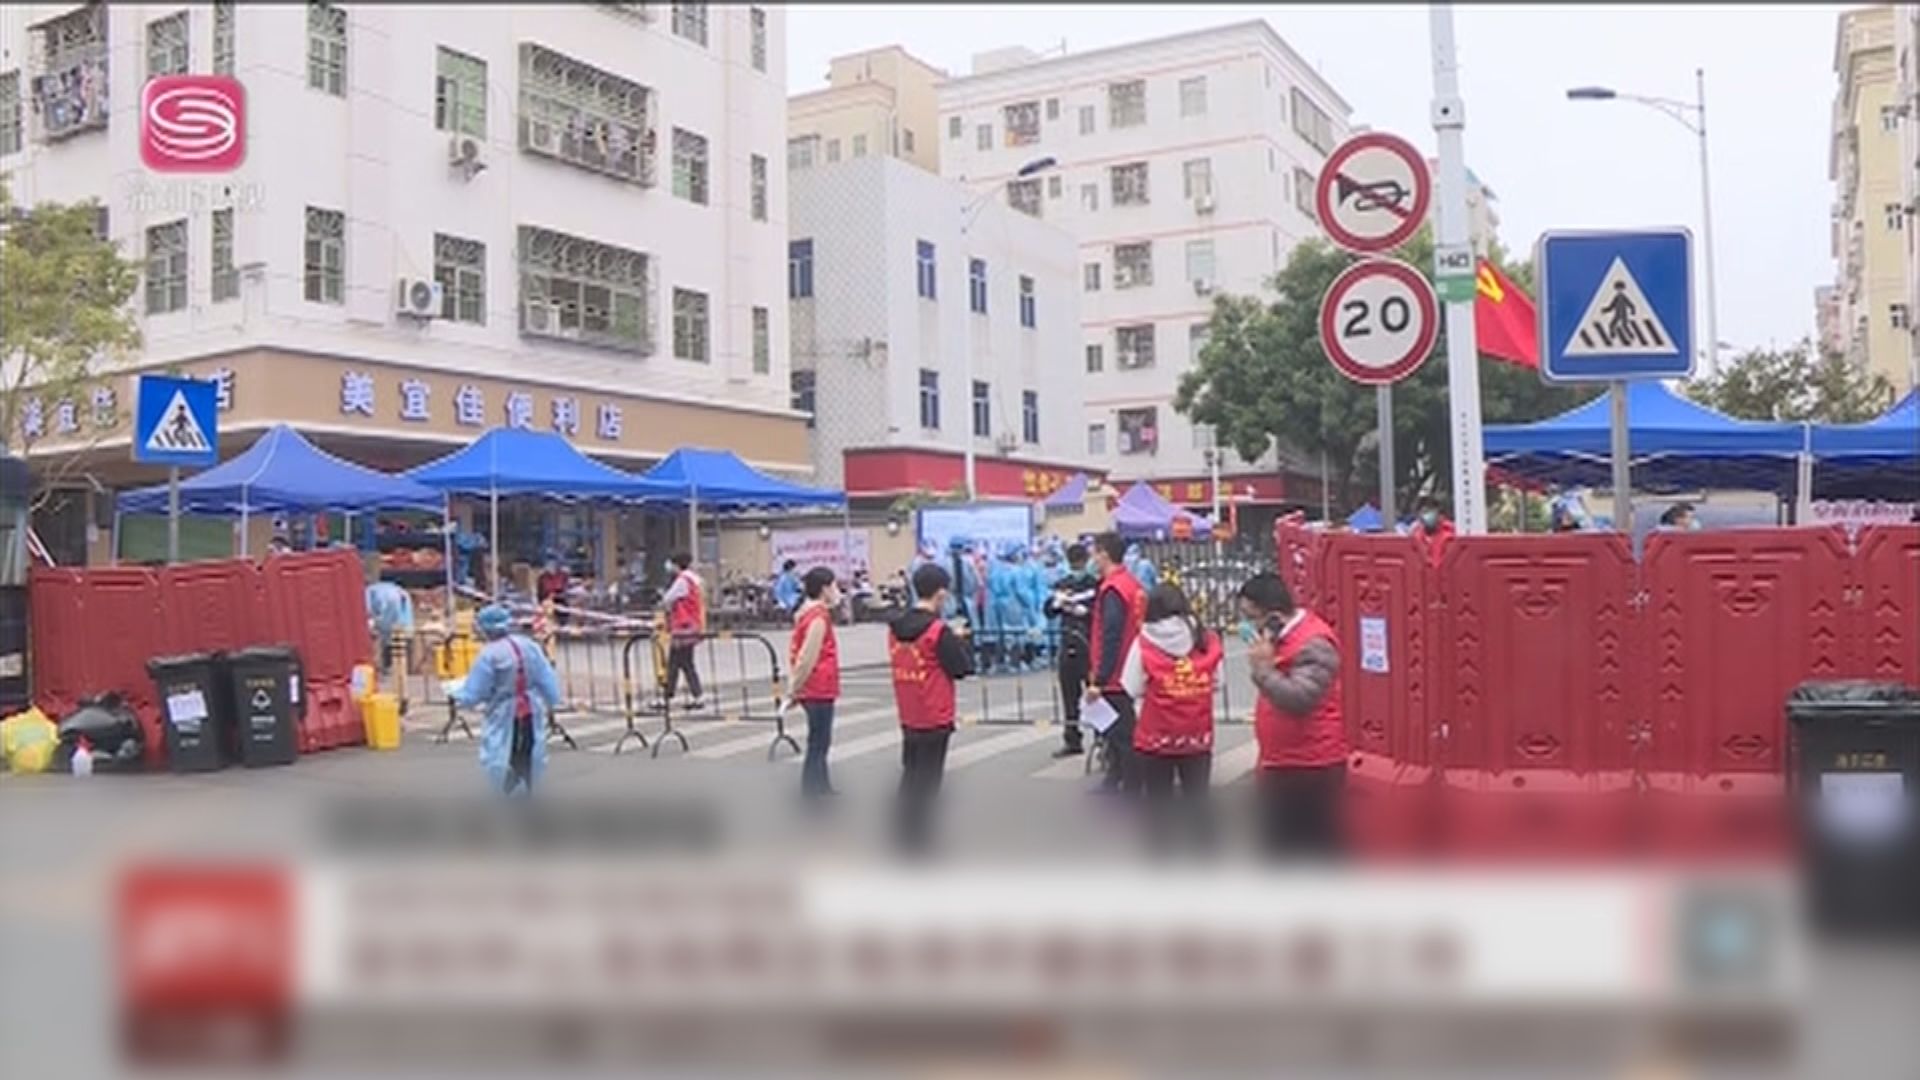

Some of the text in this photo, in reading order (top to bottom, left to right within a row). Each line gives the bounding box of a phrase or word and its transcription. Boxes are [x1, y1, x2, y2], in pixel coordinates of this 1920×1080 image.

[1343, 296, 1409, 337] 20
[341, 371, 622, 440] 美宜佳便利店
